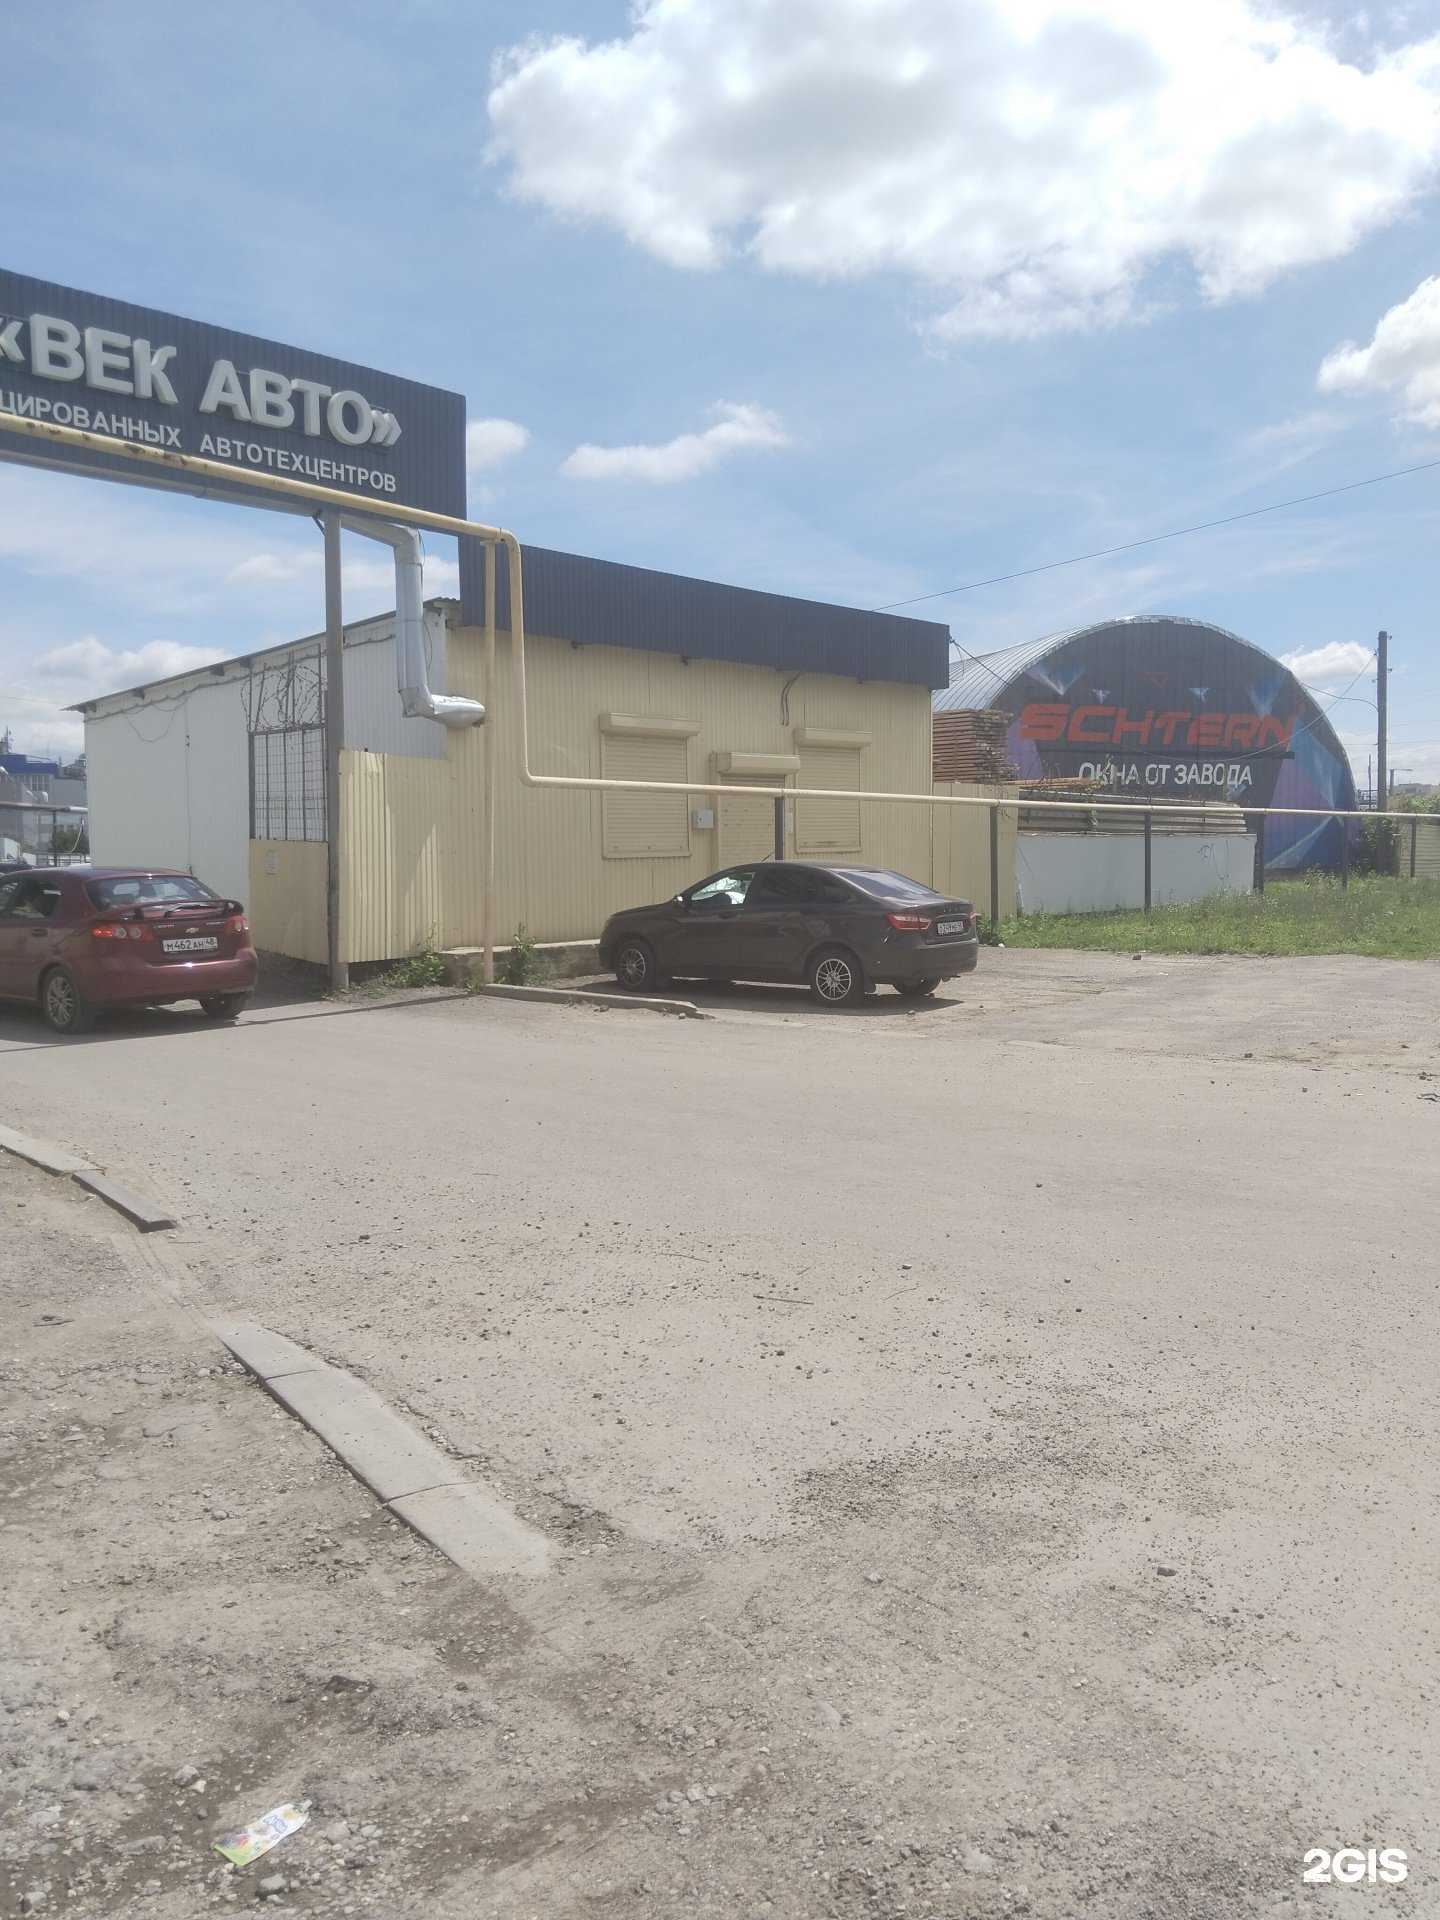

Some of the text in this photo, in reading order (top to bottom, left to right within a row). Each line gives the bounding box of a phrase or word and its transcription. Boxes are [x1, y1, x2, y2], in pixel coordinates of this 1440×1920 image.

[199, 359, 402, 447] АВТО»
[200, 434, 397, 493] АВТОТЕХЦЕНТРОВ
[1018, 703, 1297, 751] SCHTERN
[1145, 763, 1171, 786] ОТ
[1174, 763, 1253, 788] ЗАВОДА
